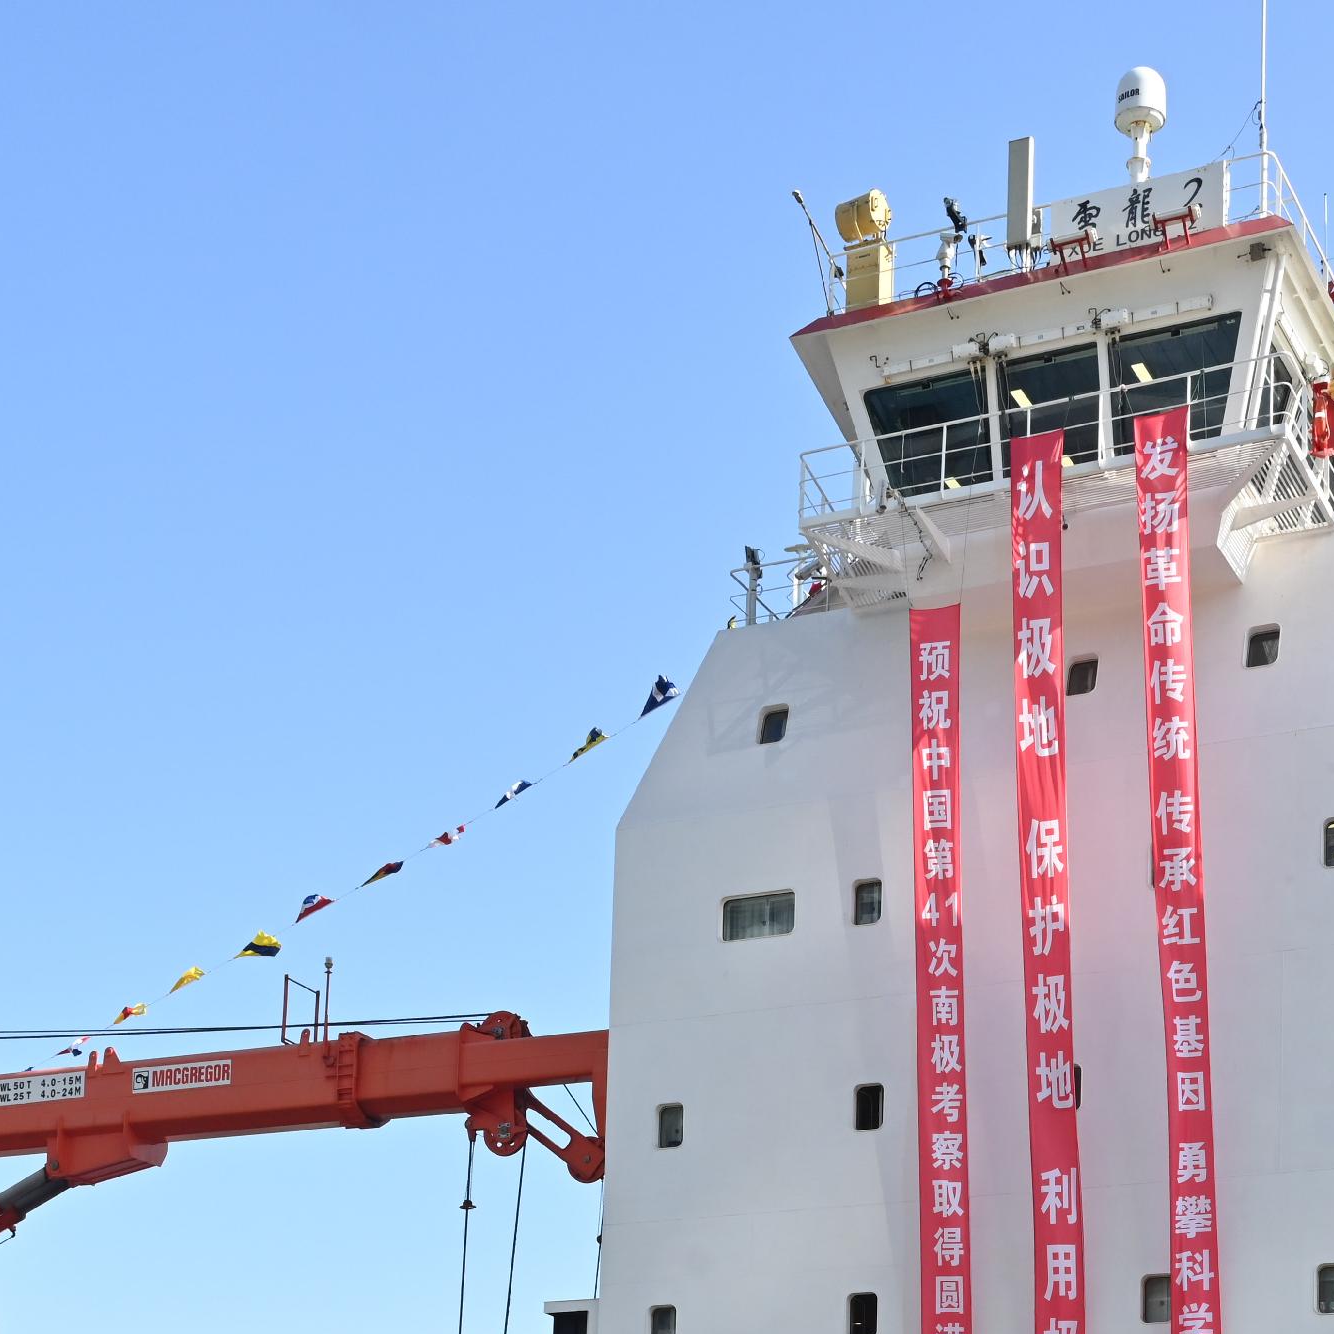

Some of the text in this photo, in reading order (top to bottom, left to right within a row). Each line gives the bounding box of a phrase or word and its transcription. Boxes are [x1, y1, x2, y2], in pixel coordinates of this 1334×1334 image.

[1017, 460, 1059, 757] 认识极地
[1141, 435, 1191, 761] 发扬革命传统
[41, 1075, 82, 1088] 4.0-15M
[41, 1087, 81, 1099] 4.0-24M
[152, 1064, 230, 1088] MACGREGOR
[1025, 818, 1073, 1109] 保护极地
[1156, 790, 1206, 1112] 传承红色基因
